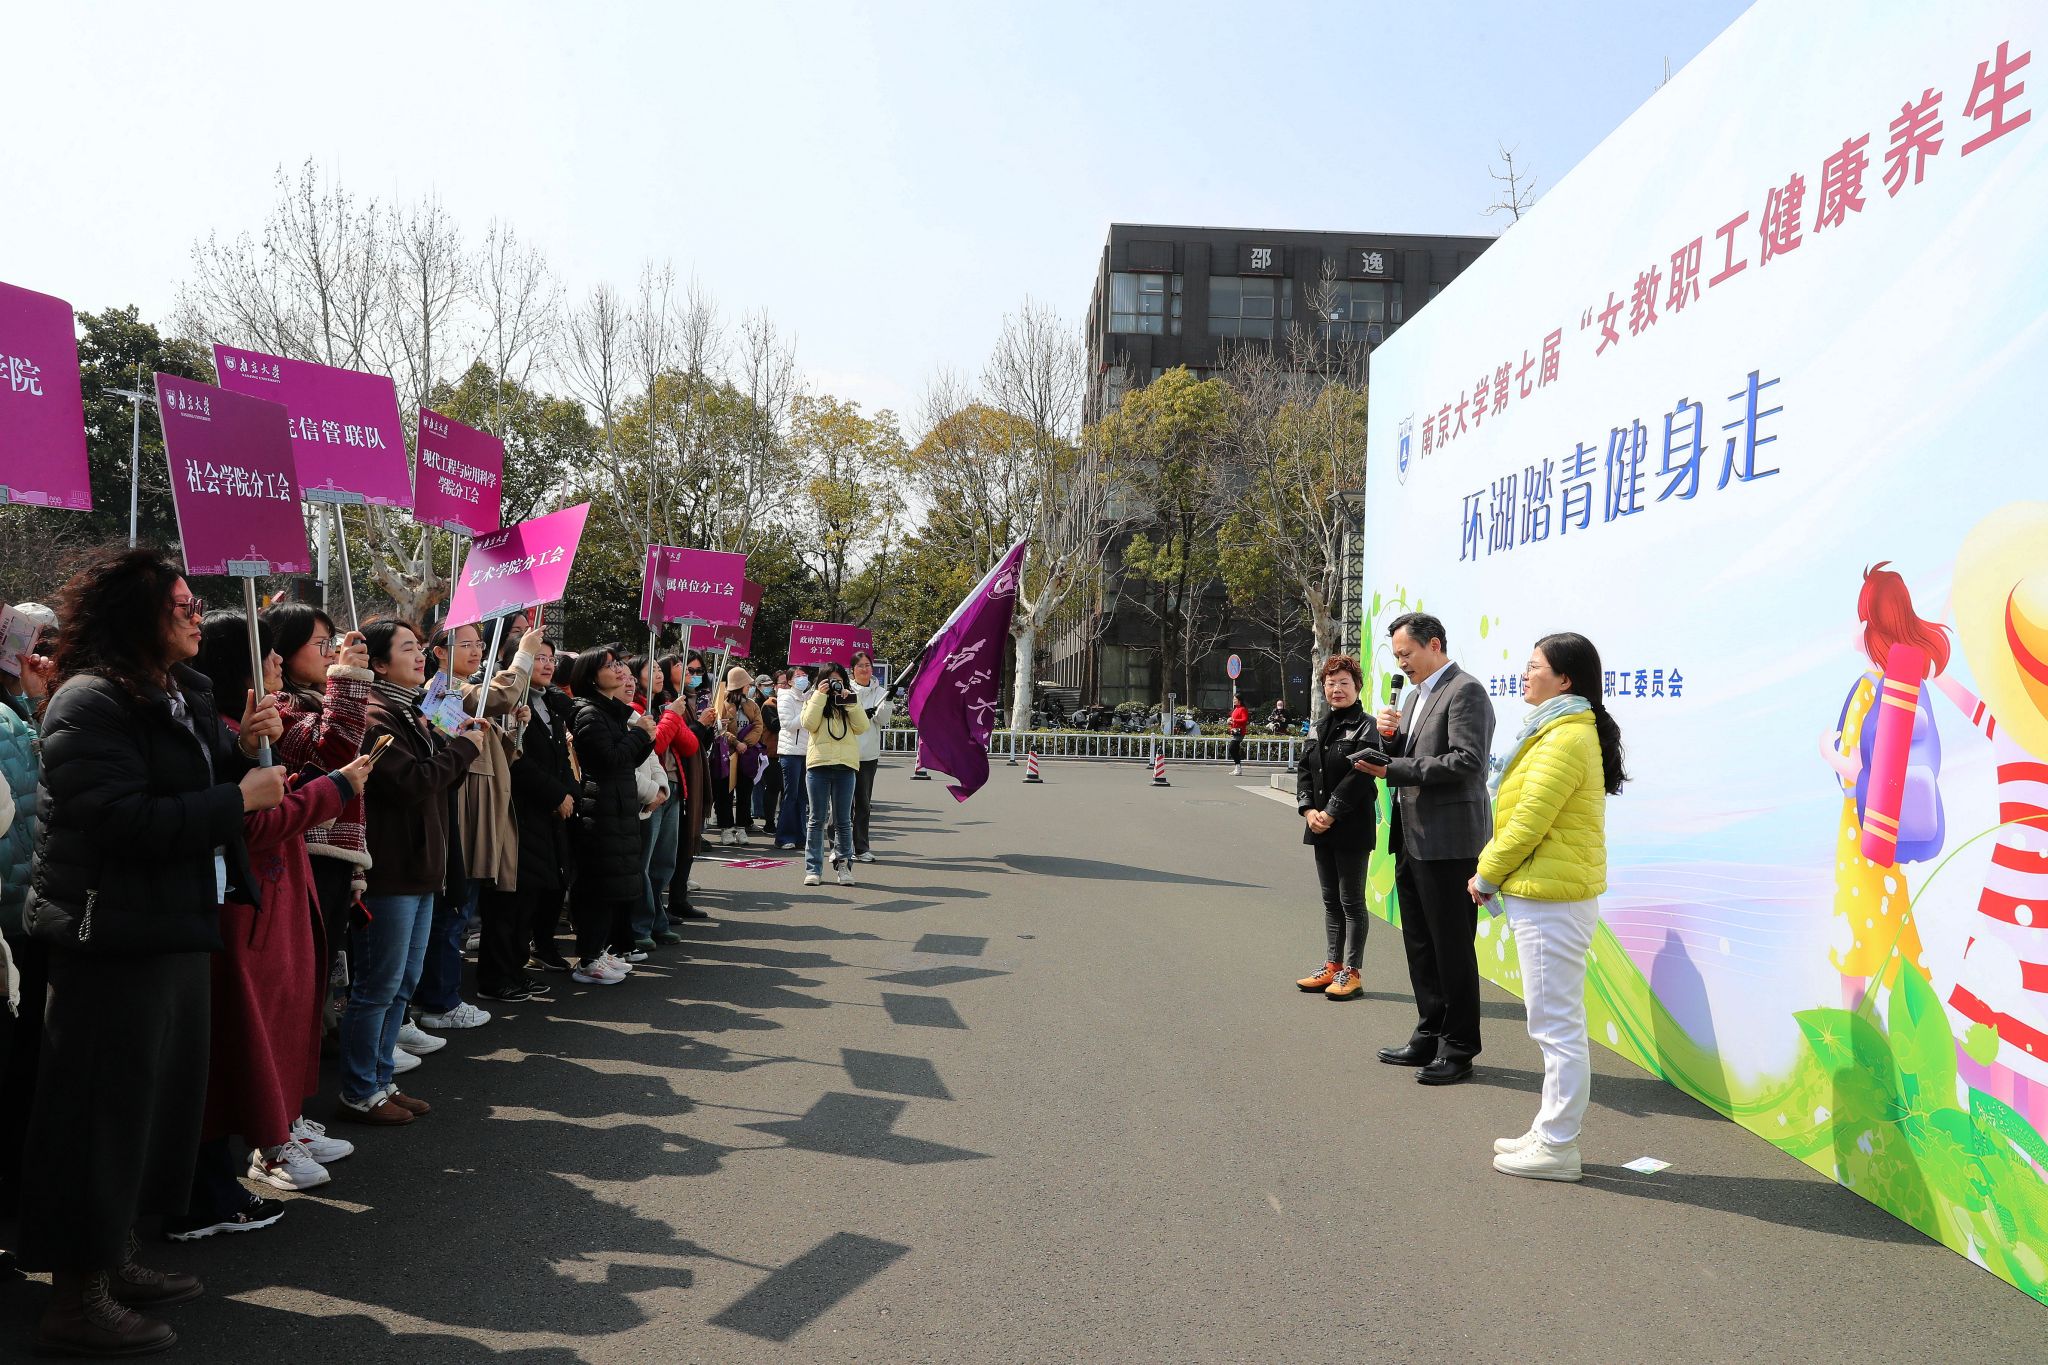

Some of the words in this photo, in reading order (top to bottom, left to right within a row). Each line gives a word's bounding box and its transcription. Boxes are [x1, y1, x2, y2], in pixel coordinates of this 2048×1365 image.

[184, 458, 291, 503] 社会学院分工会
[423, 449, 497, 488] 现代工程与应用科学
[1459, 369, 1784, 562] 环湖踏青健身走
[438, 475, 480, 504] 学院分工会
[468, 546, 565, 587] 艺术学院分工会
[799, 635, 845, 647] 政府管理学院
[810, 646, 833, 655] 分工会
[1604, 668, 1683, 698] 职工委员会
